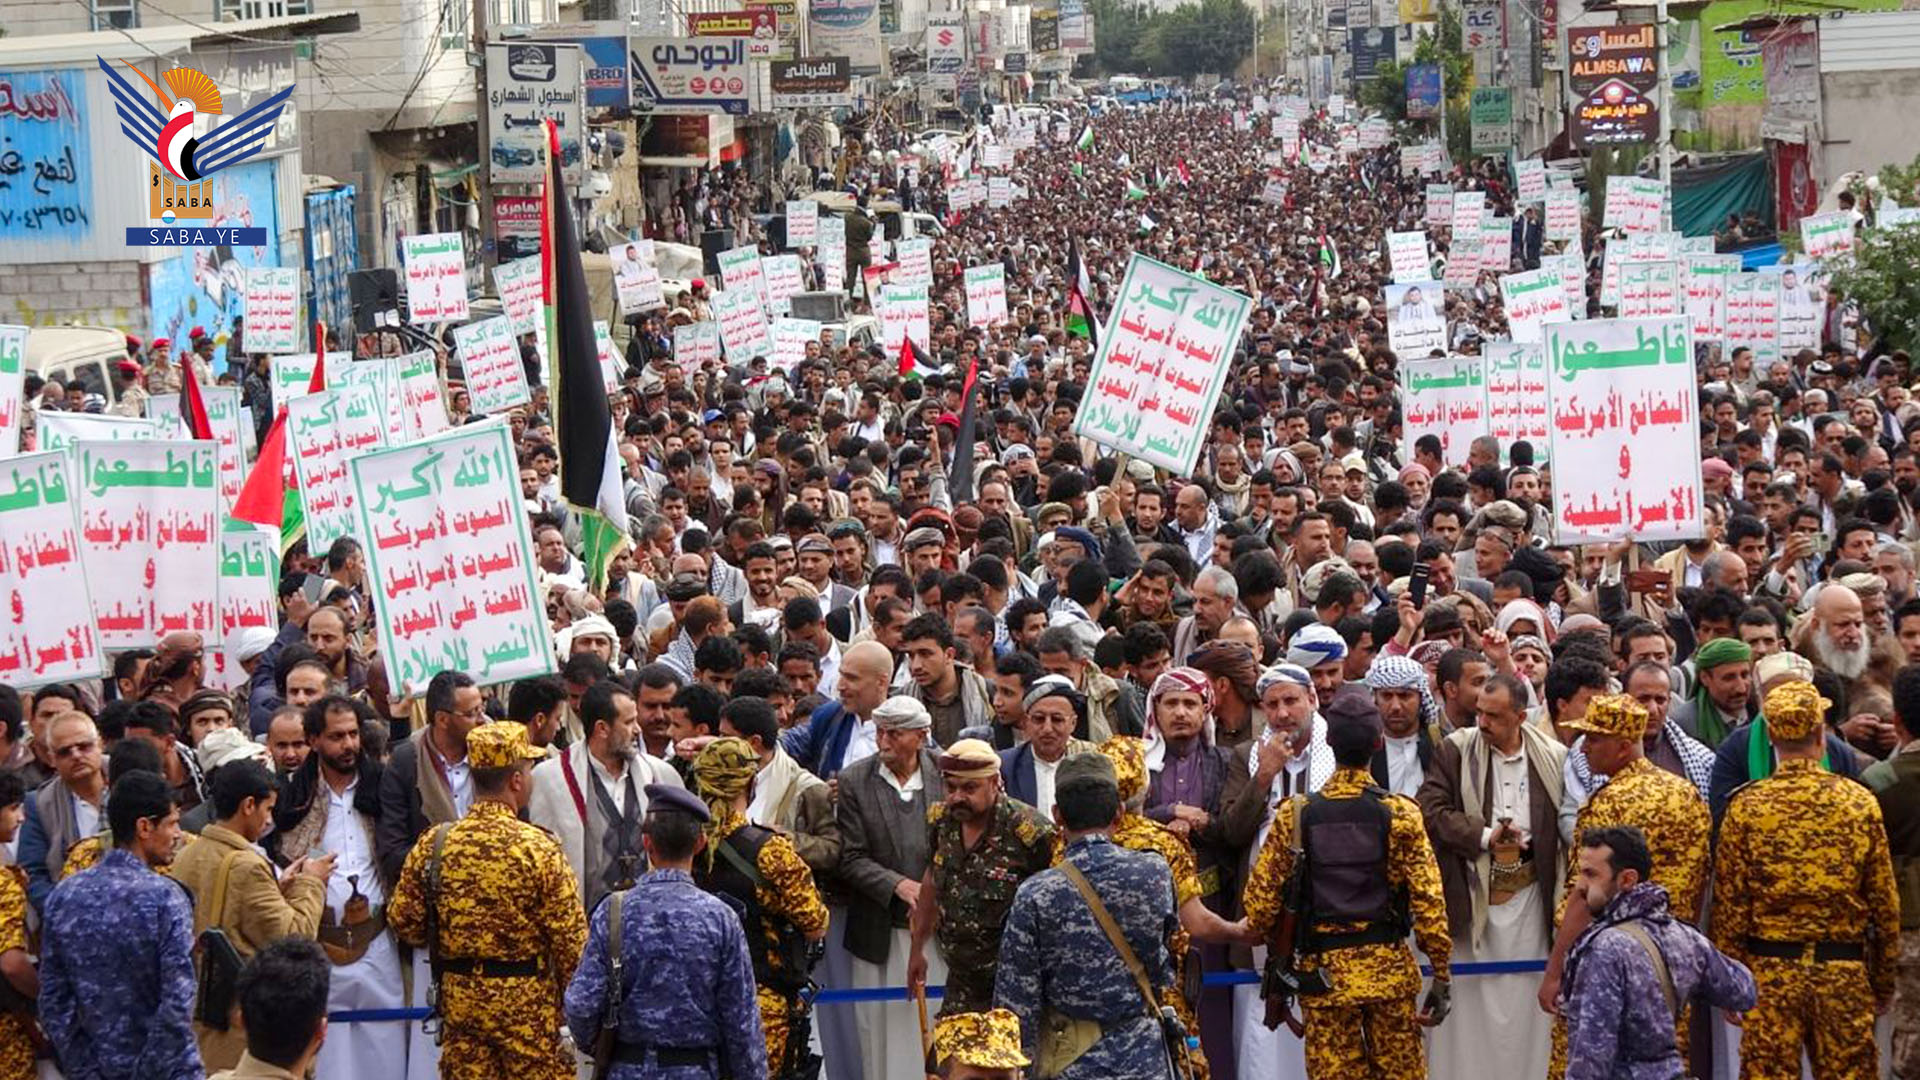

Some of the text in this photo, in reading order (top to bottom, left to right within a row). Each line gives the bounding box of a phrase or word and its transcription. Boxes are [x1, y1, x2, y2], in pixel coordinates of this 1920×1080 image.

[653, 40, 743, 72] الجوحي
[1573, 57, 1655, 75] ALMSAWA
[1130, 280, 1235, 334] الله أكبر
[1120, 308, 1221, 366] الموت لأمريكا
[1552, 323, 1687, 382] قاطعوا
[1097, 375, 1200, 428] اللعنة على اليهود
[1165, 365, 1210, 397] الموت
[1406, 361, 1482, 396] قاطعوا
[296, 393, 375, 436] الله أكبر
[1449, 400, 1484, 426] البضائع
[1554, 384, 1690, 438] البضائع الأمريكية
[1139, 428, 1190, 460] النصر
[1618, 444, 1631, 479] و
[0, 461, 67, 512] قاط
[82, 449, 214, 498] قاطعوا
[369, 445, 503, 517] الله أكبر
[83, 502, 214, 551] البضائع الأمريكية
[374, 497, 512, 550] الموت لأمريكا
[1563, 486, 1694, 536] الإسرائيلية
[16, 527, 78, 579] البضائع
[143, 557, 156, 589] و
[221, 541, 265, 577] قاط
[385, 541, 521, 600] الموت لإسرائيل
[11, 589, 24, 626] و
[392, 583, 529, 640] اللعنة على اليهود
[480, 622, 538, 677] النصر
